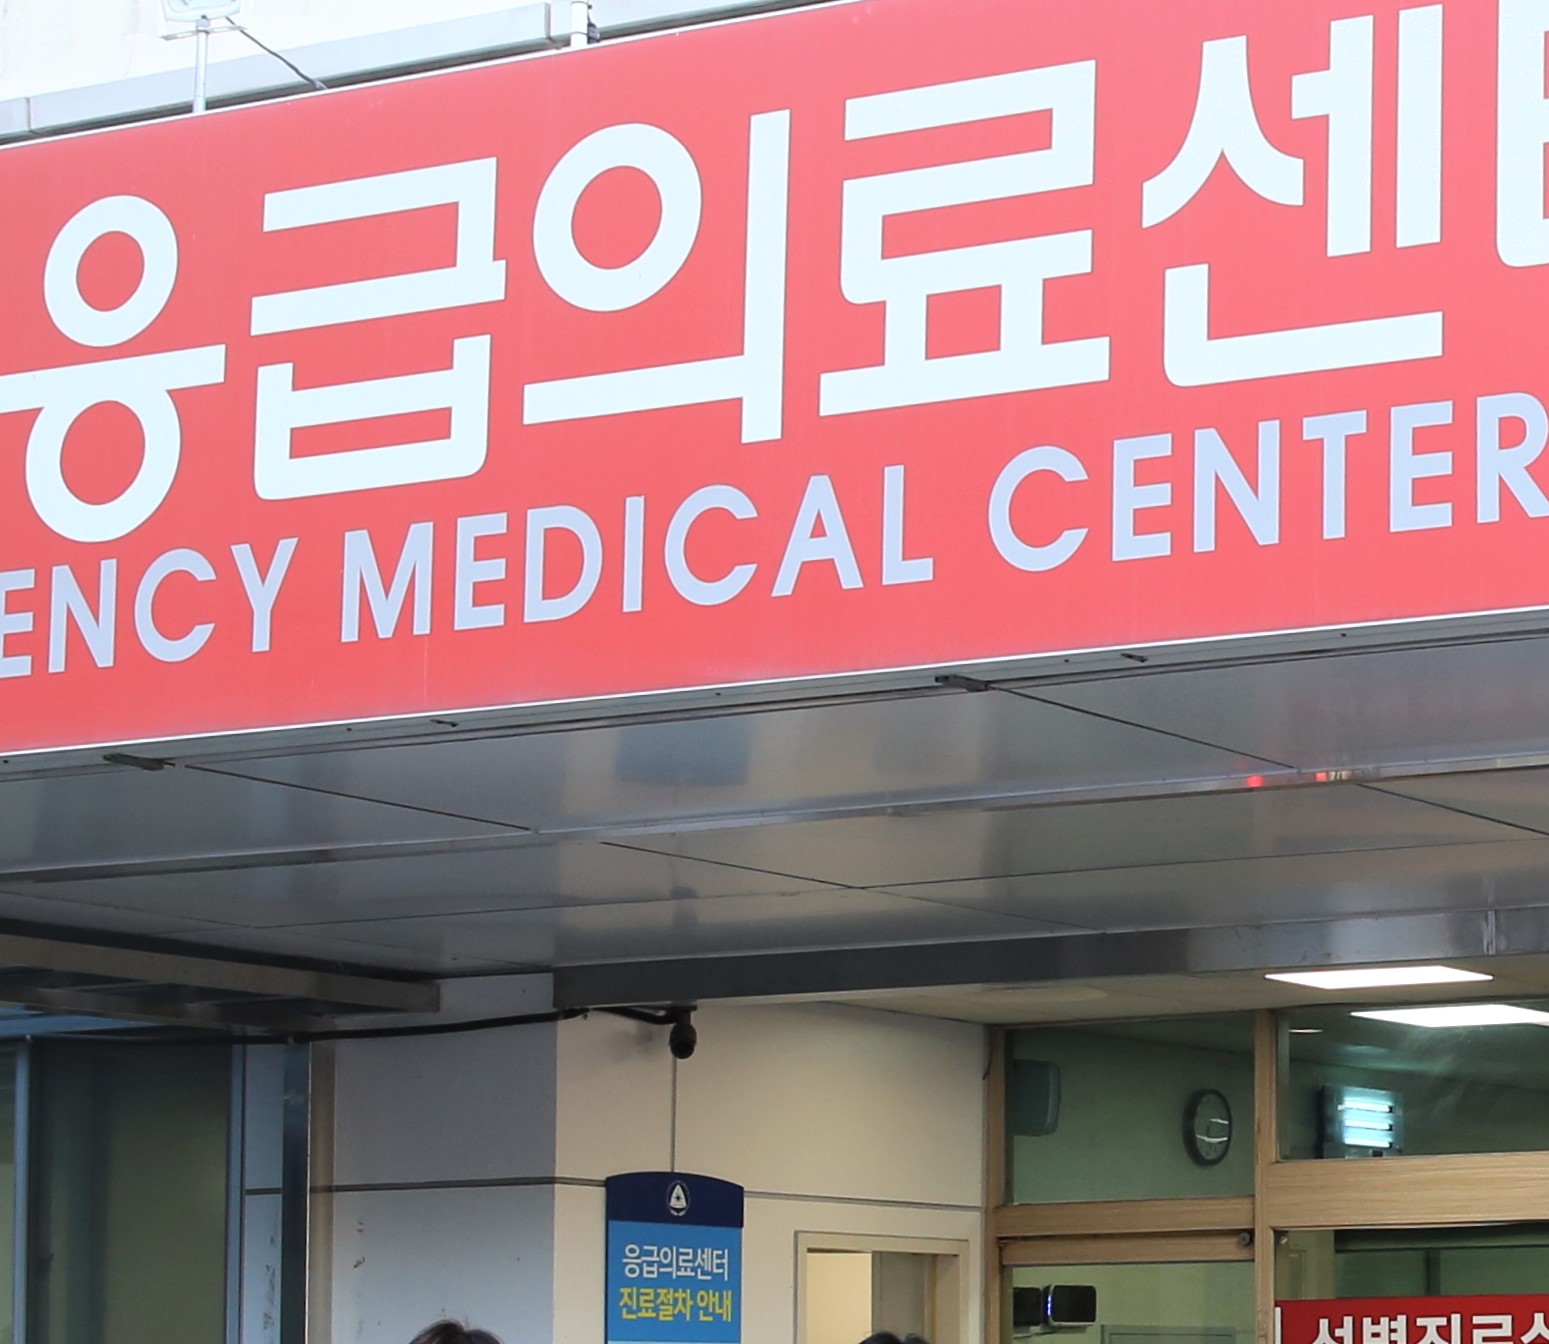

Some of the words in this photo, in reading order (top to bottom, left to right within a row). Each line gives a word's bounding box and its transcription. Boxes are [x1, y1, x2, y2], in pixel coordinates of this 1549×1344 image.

[341, 463, 934, 645] MEDICAL
[622, 1243, 729, 1282] 응급의료센터
[619, 1286, 694, 1322] 진료절차
[697, 1289, 733, 1323] 안내
